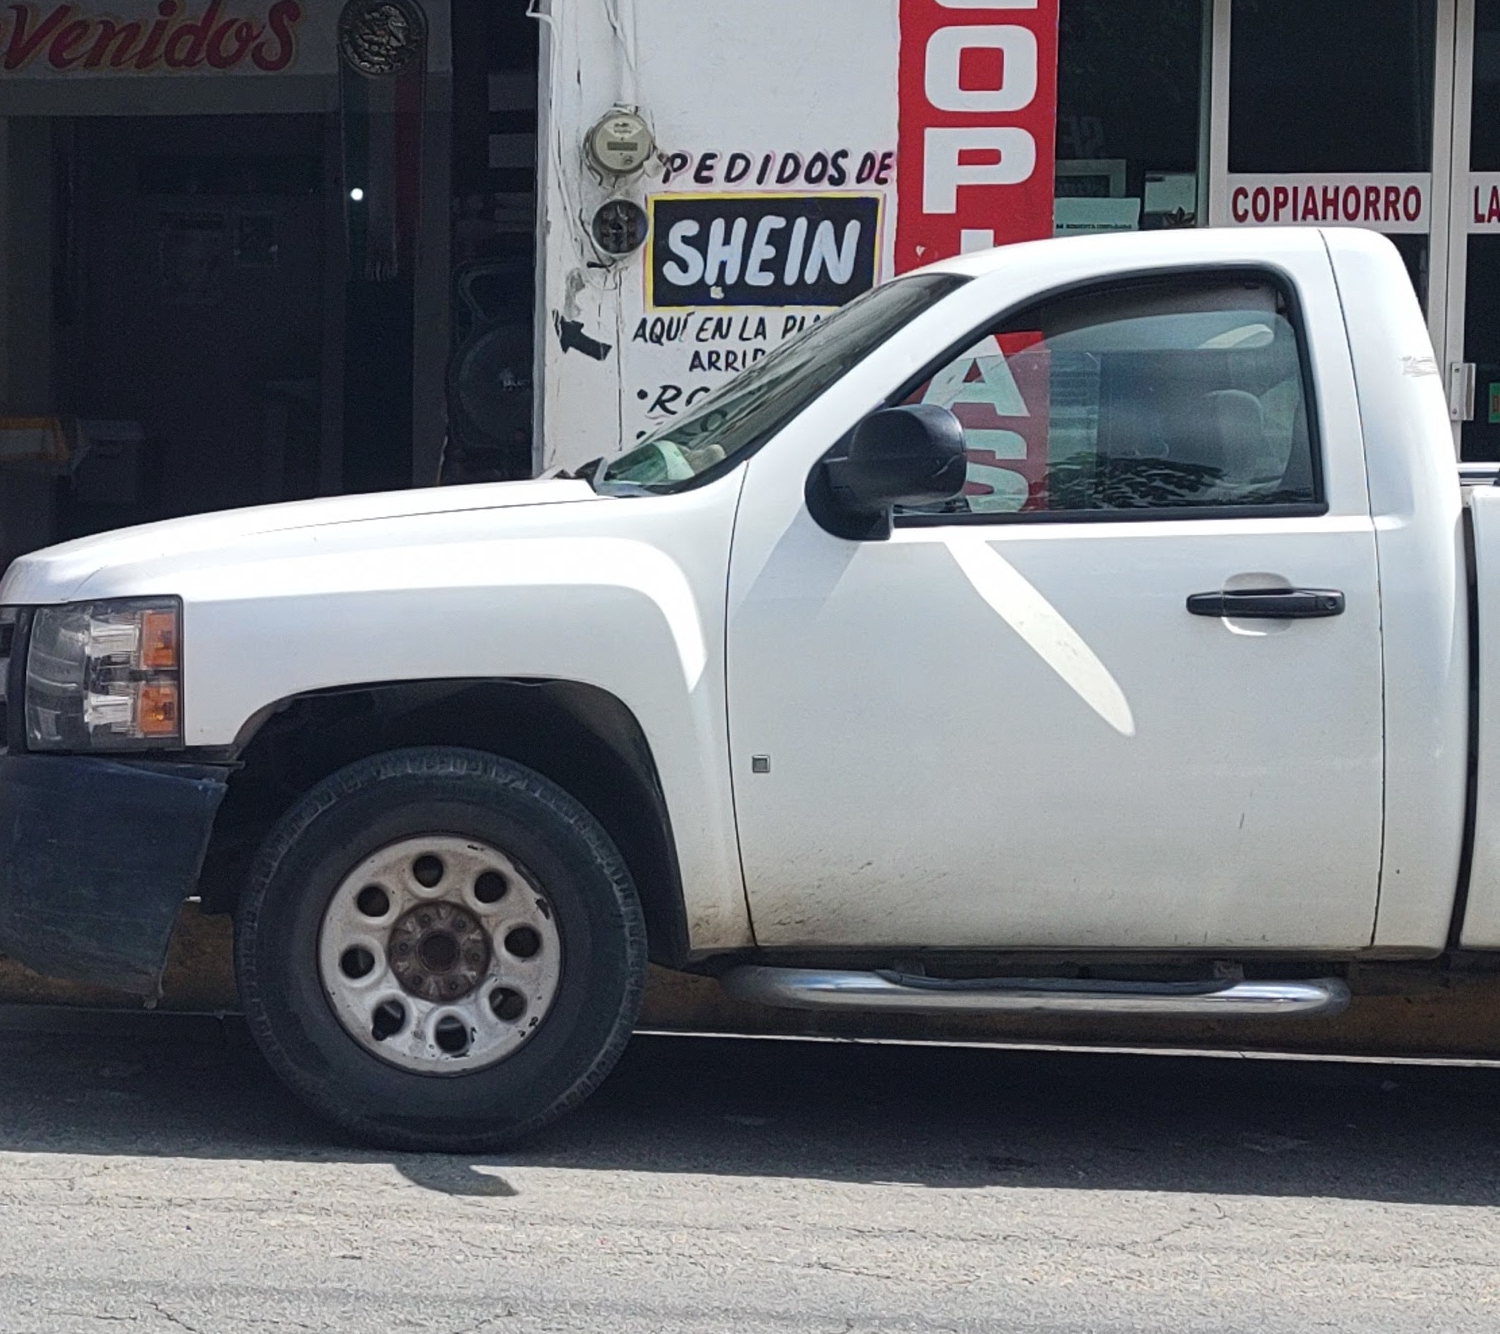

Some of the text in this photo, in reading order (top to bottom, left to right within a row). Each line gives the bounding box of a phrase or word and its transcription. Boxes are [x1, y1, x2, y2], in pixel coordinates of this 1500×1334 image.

[661, 149, 894, 187] PEDIDOS DE
[1231, 185, 1422, 224] COPIAHORRO
[662, 214, 862, 287] SHEIN
[695, 315, 733, 343] EN
[738, 314, 767, 342] LA
